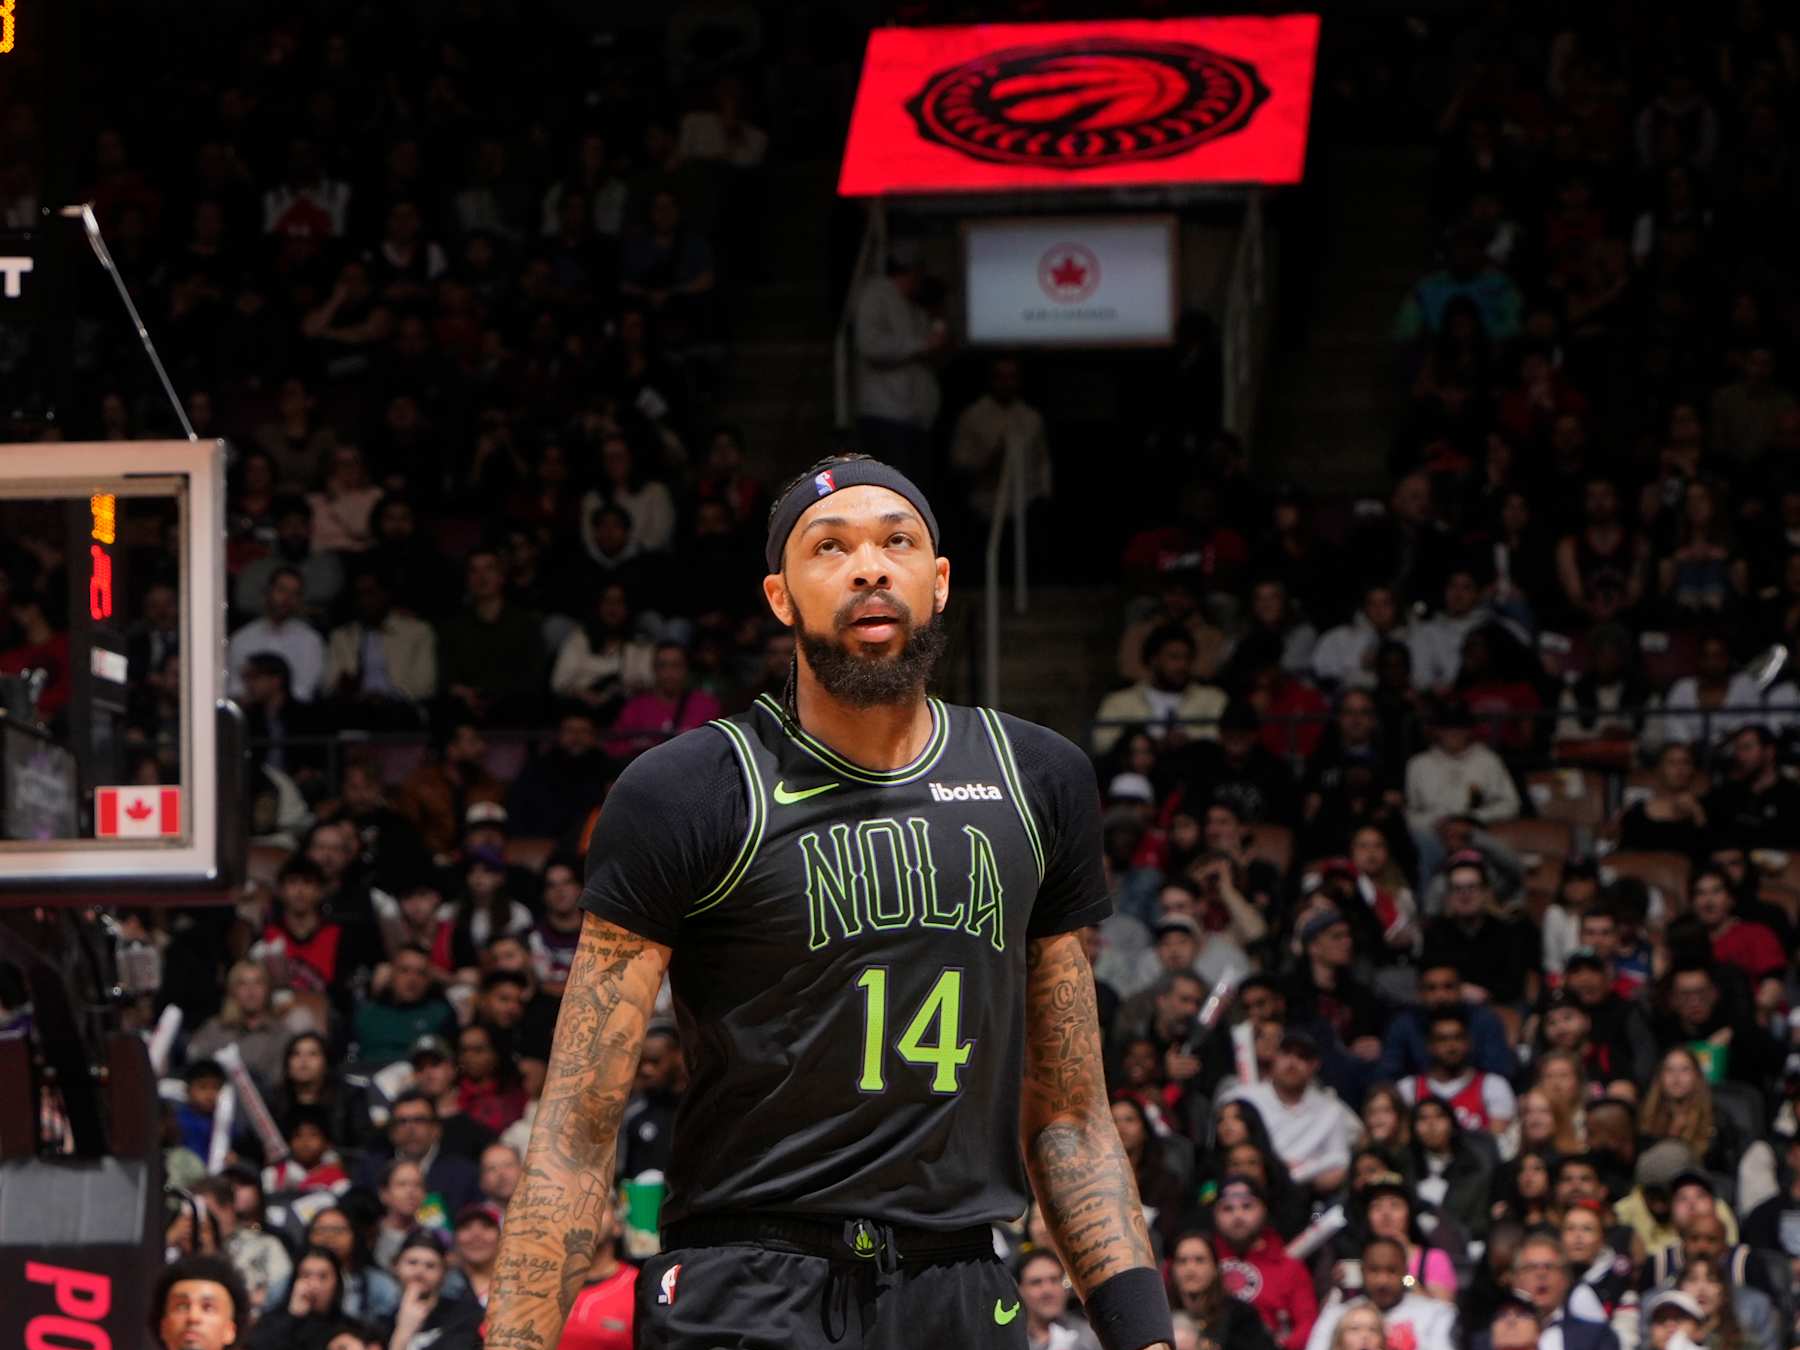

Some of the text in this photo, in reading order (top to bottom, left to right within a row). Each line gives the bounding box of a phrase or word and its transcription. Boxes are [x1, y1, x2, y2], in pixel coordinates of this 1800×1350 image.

[928, 783, 1003, 802] ibotta
[799, 817, 1005, 951] NOLA
[855, 964, 977, 1096] 14
